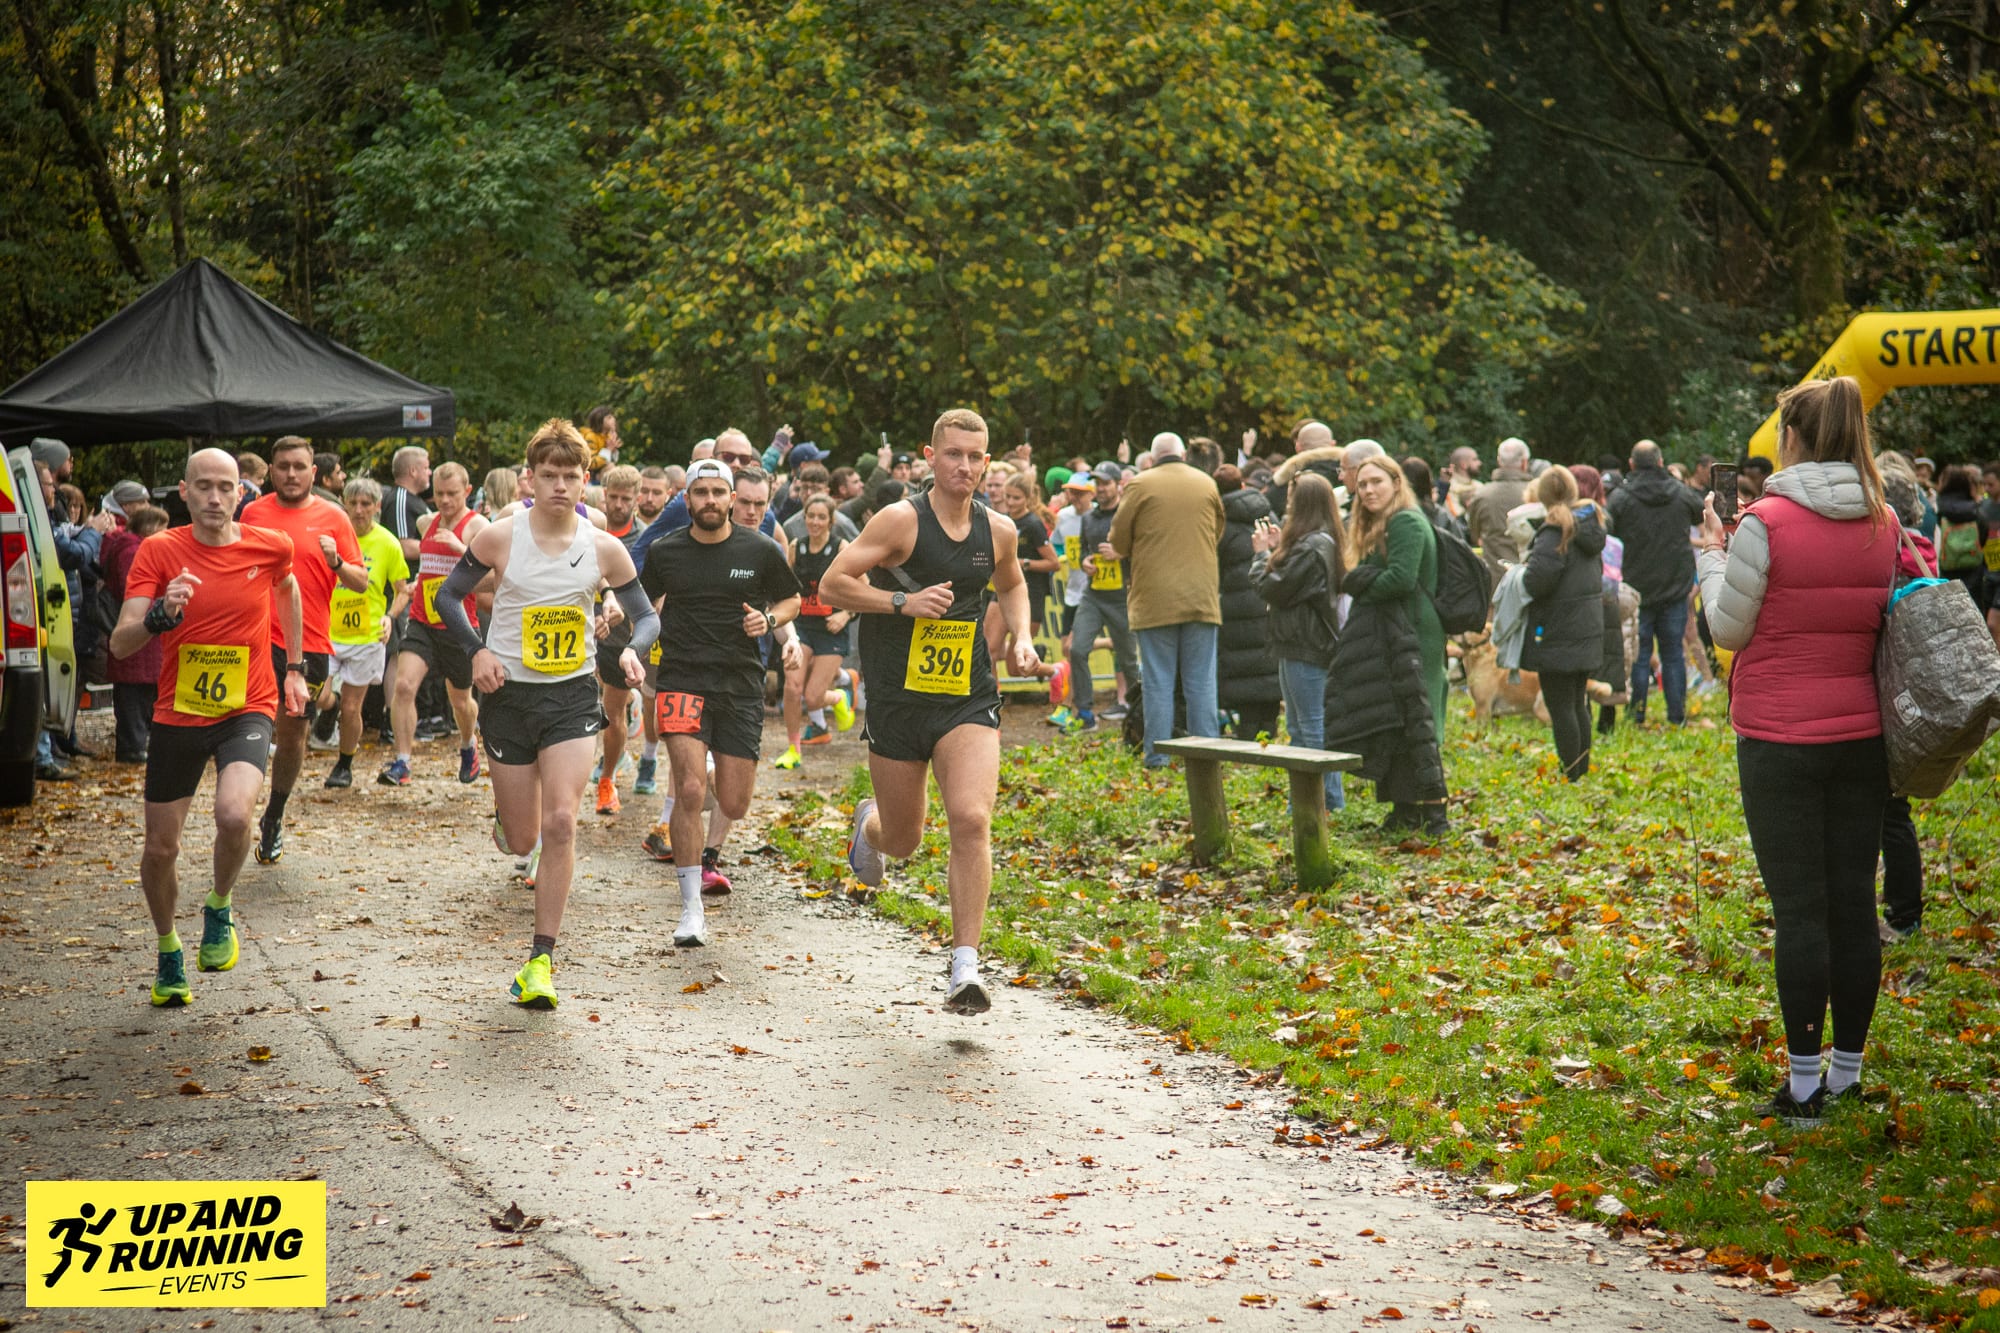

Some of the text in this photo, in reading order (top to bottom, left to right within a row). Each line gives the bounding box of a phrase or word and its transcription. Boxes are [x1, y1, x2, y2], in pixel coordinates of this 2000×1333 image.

[1879, 325, 2000, 367] START
[1095, 567, 1116, 581] 274
[342, 611, 360, 628] 40
[543, 614, 581, 626] RUNNING
[560, 609, 578, 617] AND
[951, 624, 969, 632] AND
[934, 631, 971, 640] RUNNING
[533, 630, 577, 660] 312
[217, 649, 237, 657] AND
[199, 656, 241, 665] RUNNING
[918, 644, 964, 677] 396
[193, 671, 227, 702] 46
[661, 694, 703, 719] 515
